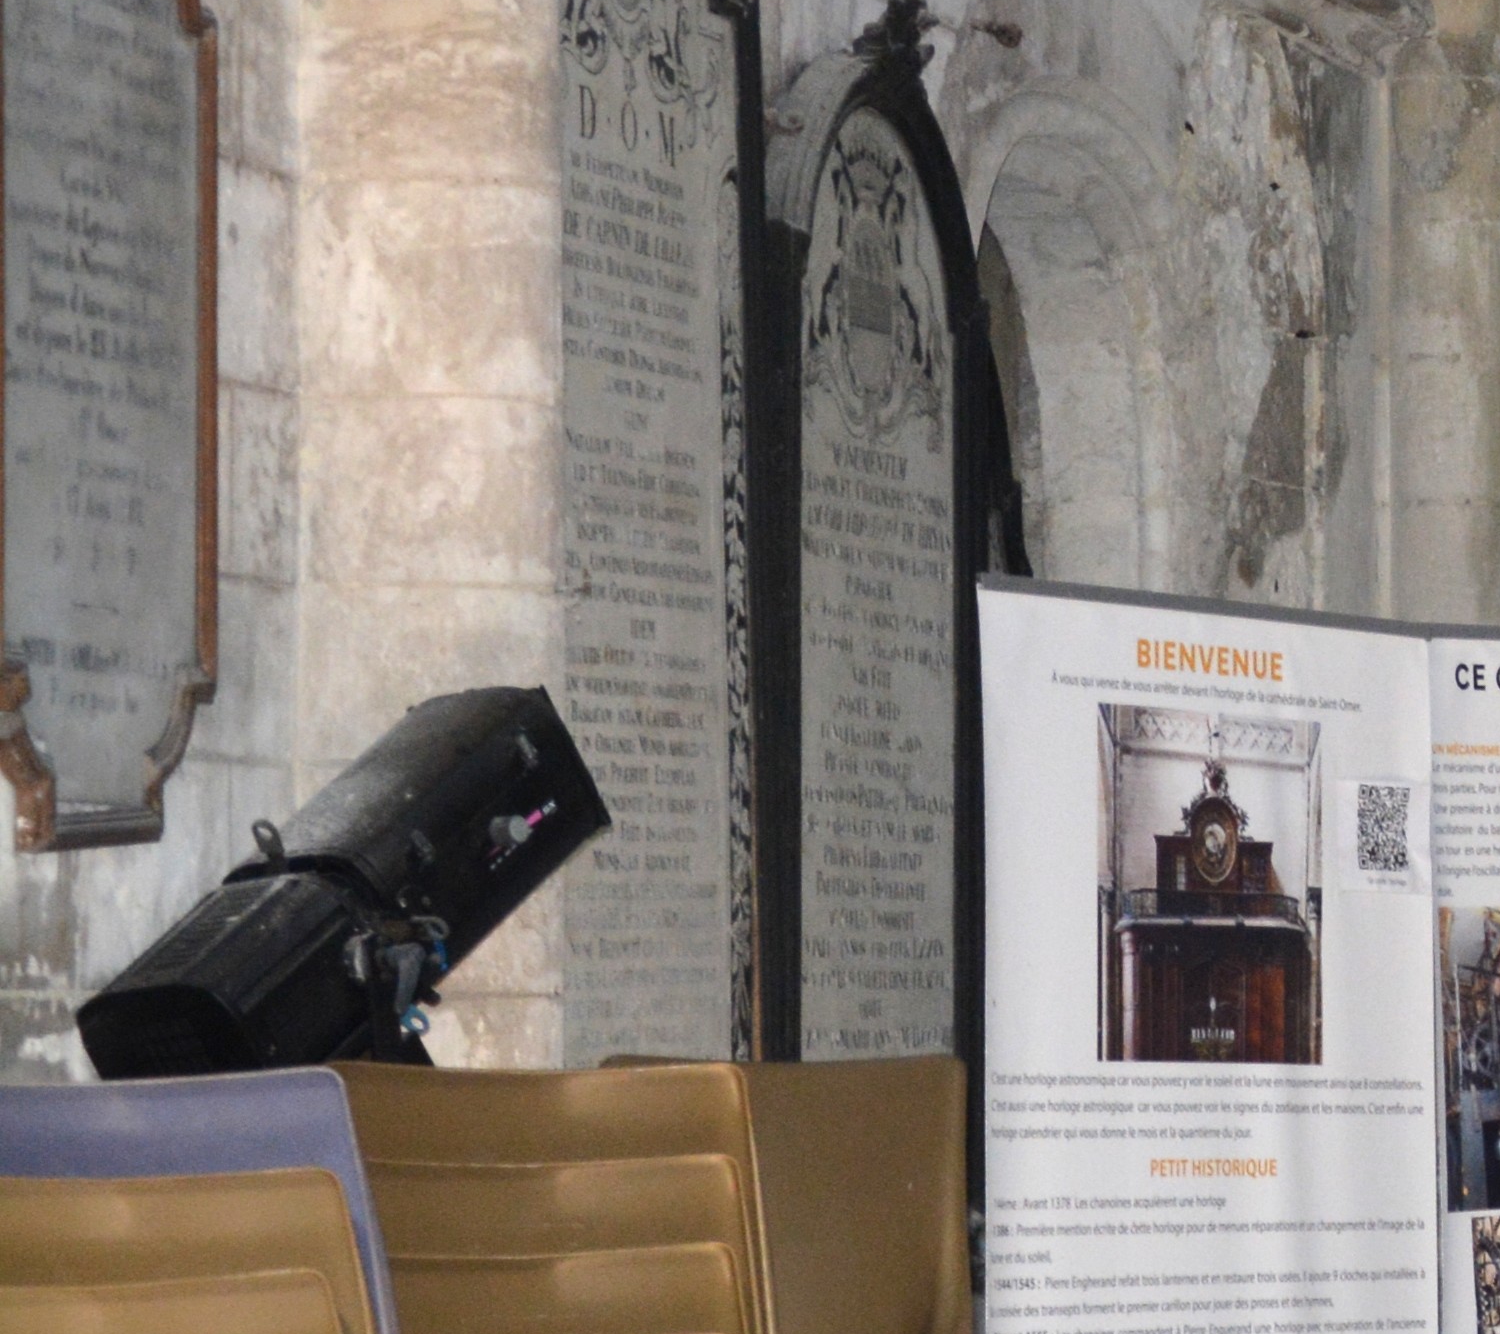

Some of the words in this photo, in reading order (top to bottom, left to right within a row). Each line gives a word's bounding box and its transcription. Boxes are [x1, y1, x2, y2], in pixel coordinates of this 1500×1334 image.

[1137, 638, 1284, 682] BIENVENUE
[1454, 663, 1486, 691] CE
[1151, 1160, 1189, 1178] PETIT
[1193, 1160, 1277, 1179] HISTORIQUE
